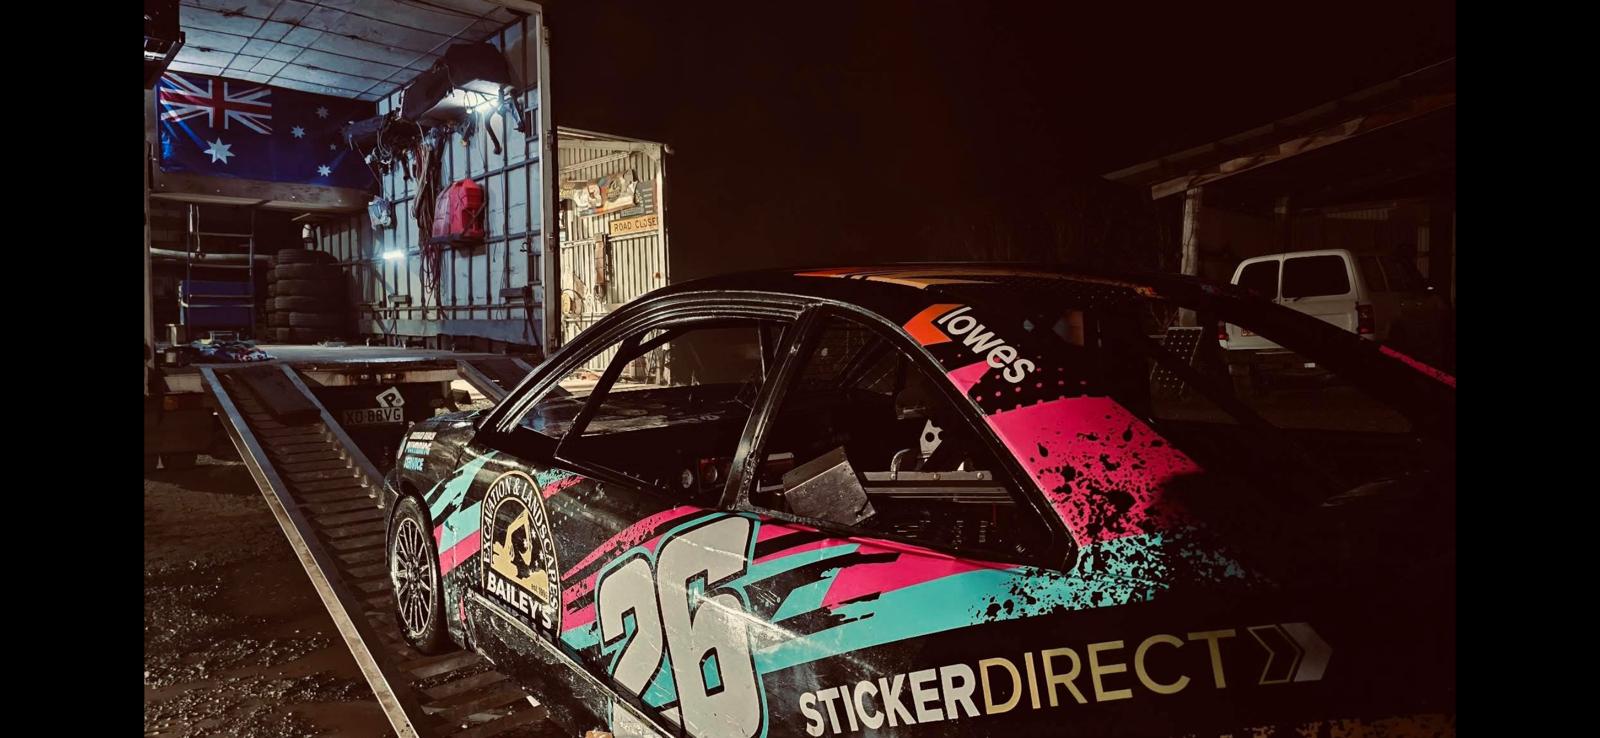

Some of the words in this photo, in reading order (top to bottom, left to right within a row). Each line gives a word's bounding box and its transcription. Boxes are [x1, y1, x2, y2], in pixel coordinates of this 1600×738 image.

[614, 221, 631, 232] ROAD
[635, 216, 659, 229] CLOSE
[937, 306, 1036, 384] lowes
[383, 393, 396, 408] P
[483, 477, 512, 564] EXCAVATION
[513, 477, 521, 496] &
[521, 483, 559, 610] LANDSCAPES
[487, 571, 553, 630] BAILEY'S
[597, 515, 763, 738] 26
